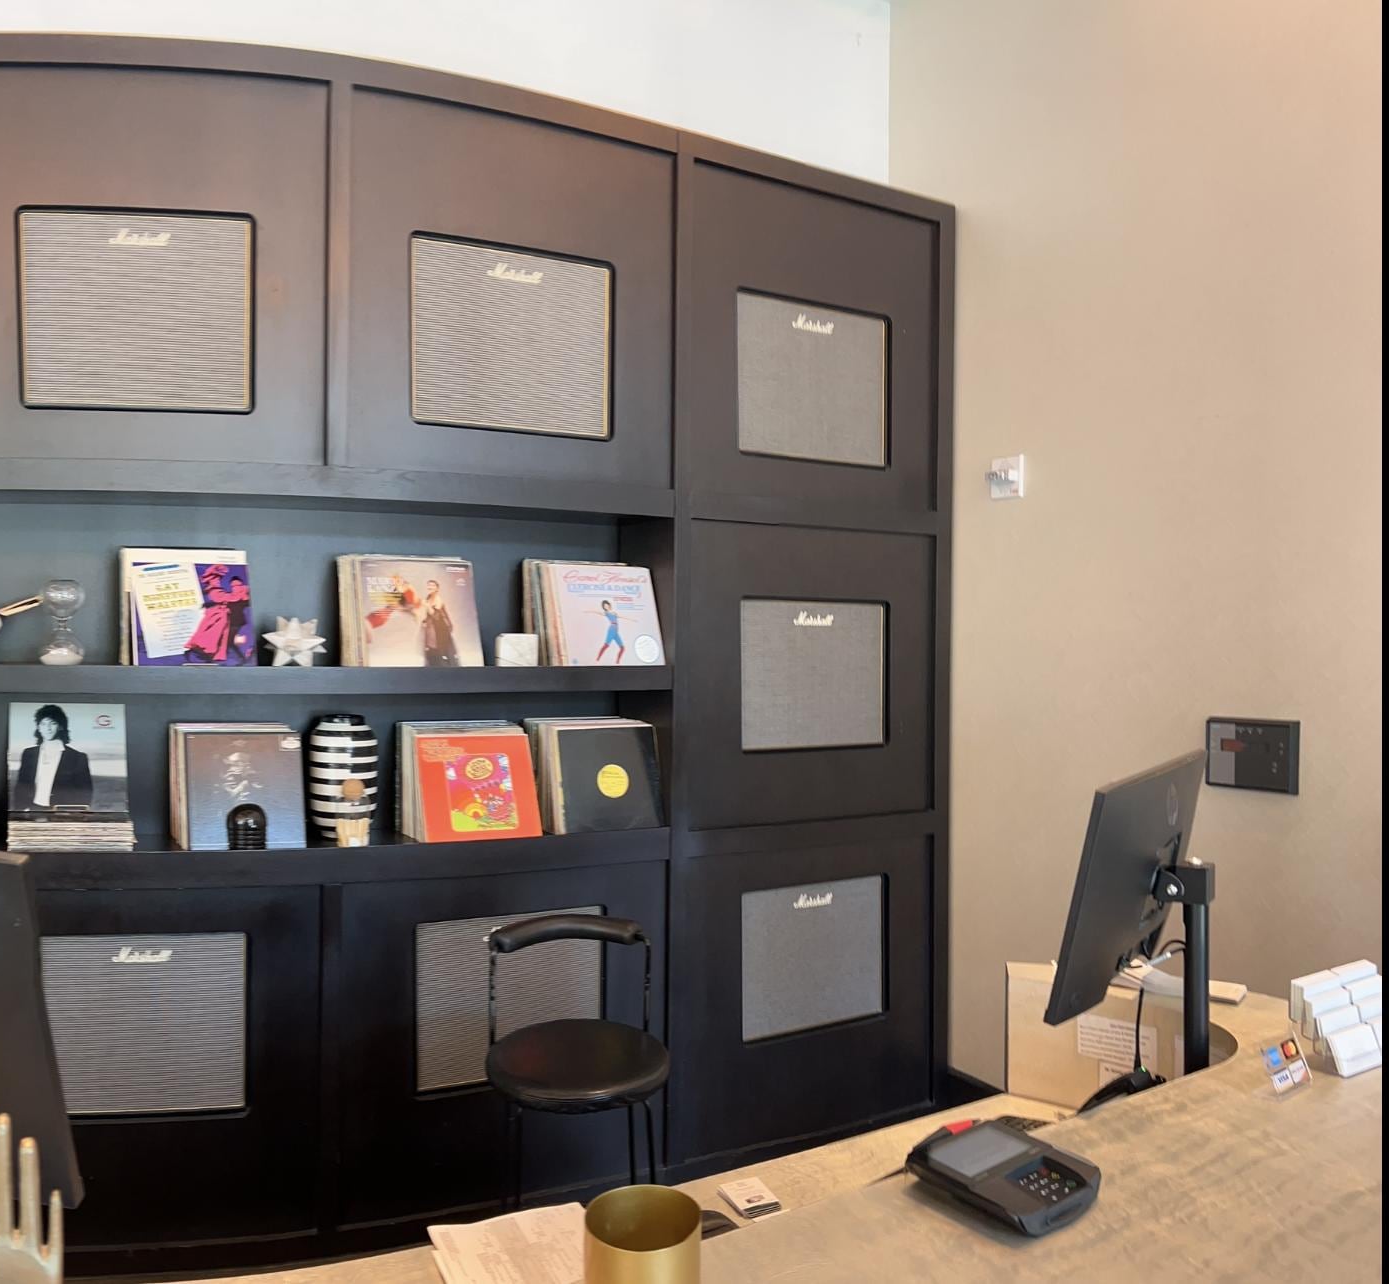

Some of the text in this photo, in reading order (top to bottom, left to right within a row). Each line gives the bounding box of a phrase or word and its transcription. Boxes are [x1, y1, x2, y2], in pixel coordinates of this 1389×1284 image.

[108, 228, 172, 247] Marshall
[487, 262, 544, 284] Marshall
[792, 313, 835, 336] Marshall
[793, 610, 835, 627] Marshall
[793, 892, 834, 910] Marshall
[112, 946, 173, 963] Marshall
